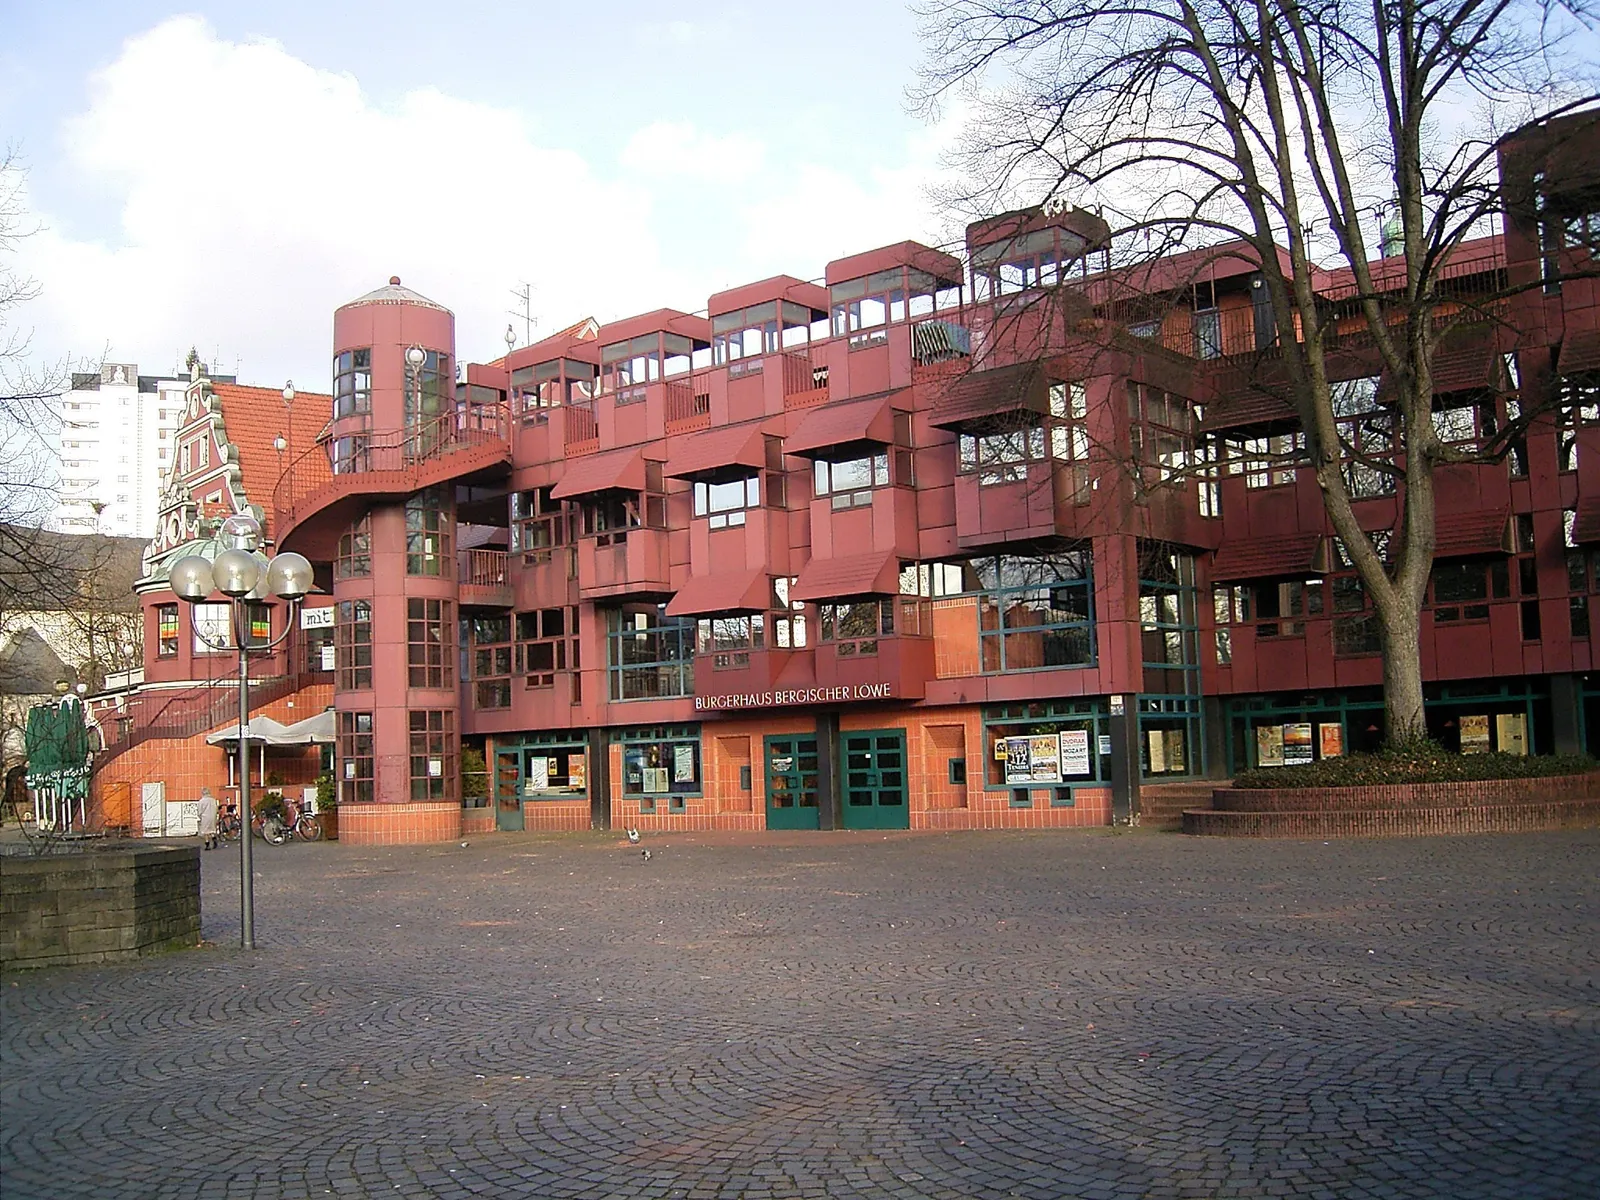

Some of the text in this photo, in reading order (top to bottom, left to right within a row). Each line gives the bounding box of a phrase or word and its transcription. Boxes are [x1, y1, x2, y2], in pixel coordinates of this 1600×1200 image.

[695, 682, 891, 709] BÜRGERHAUS BERGISCHER LÖWE
